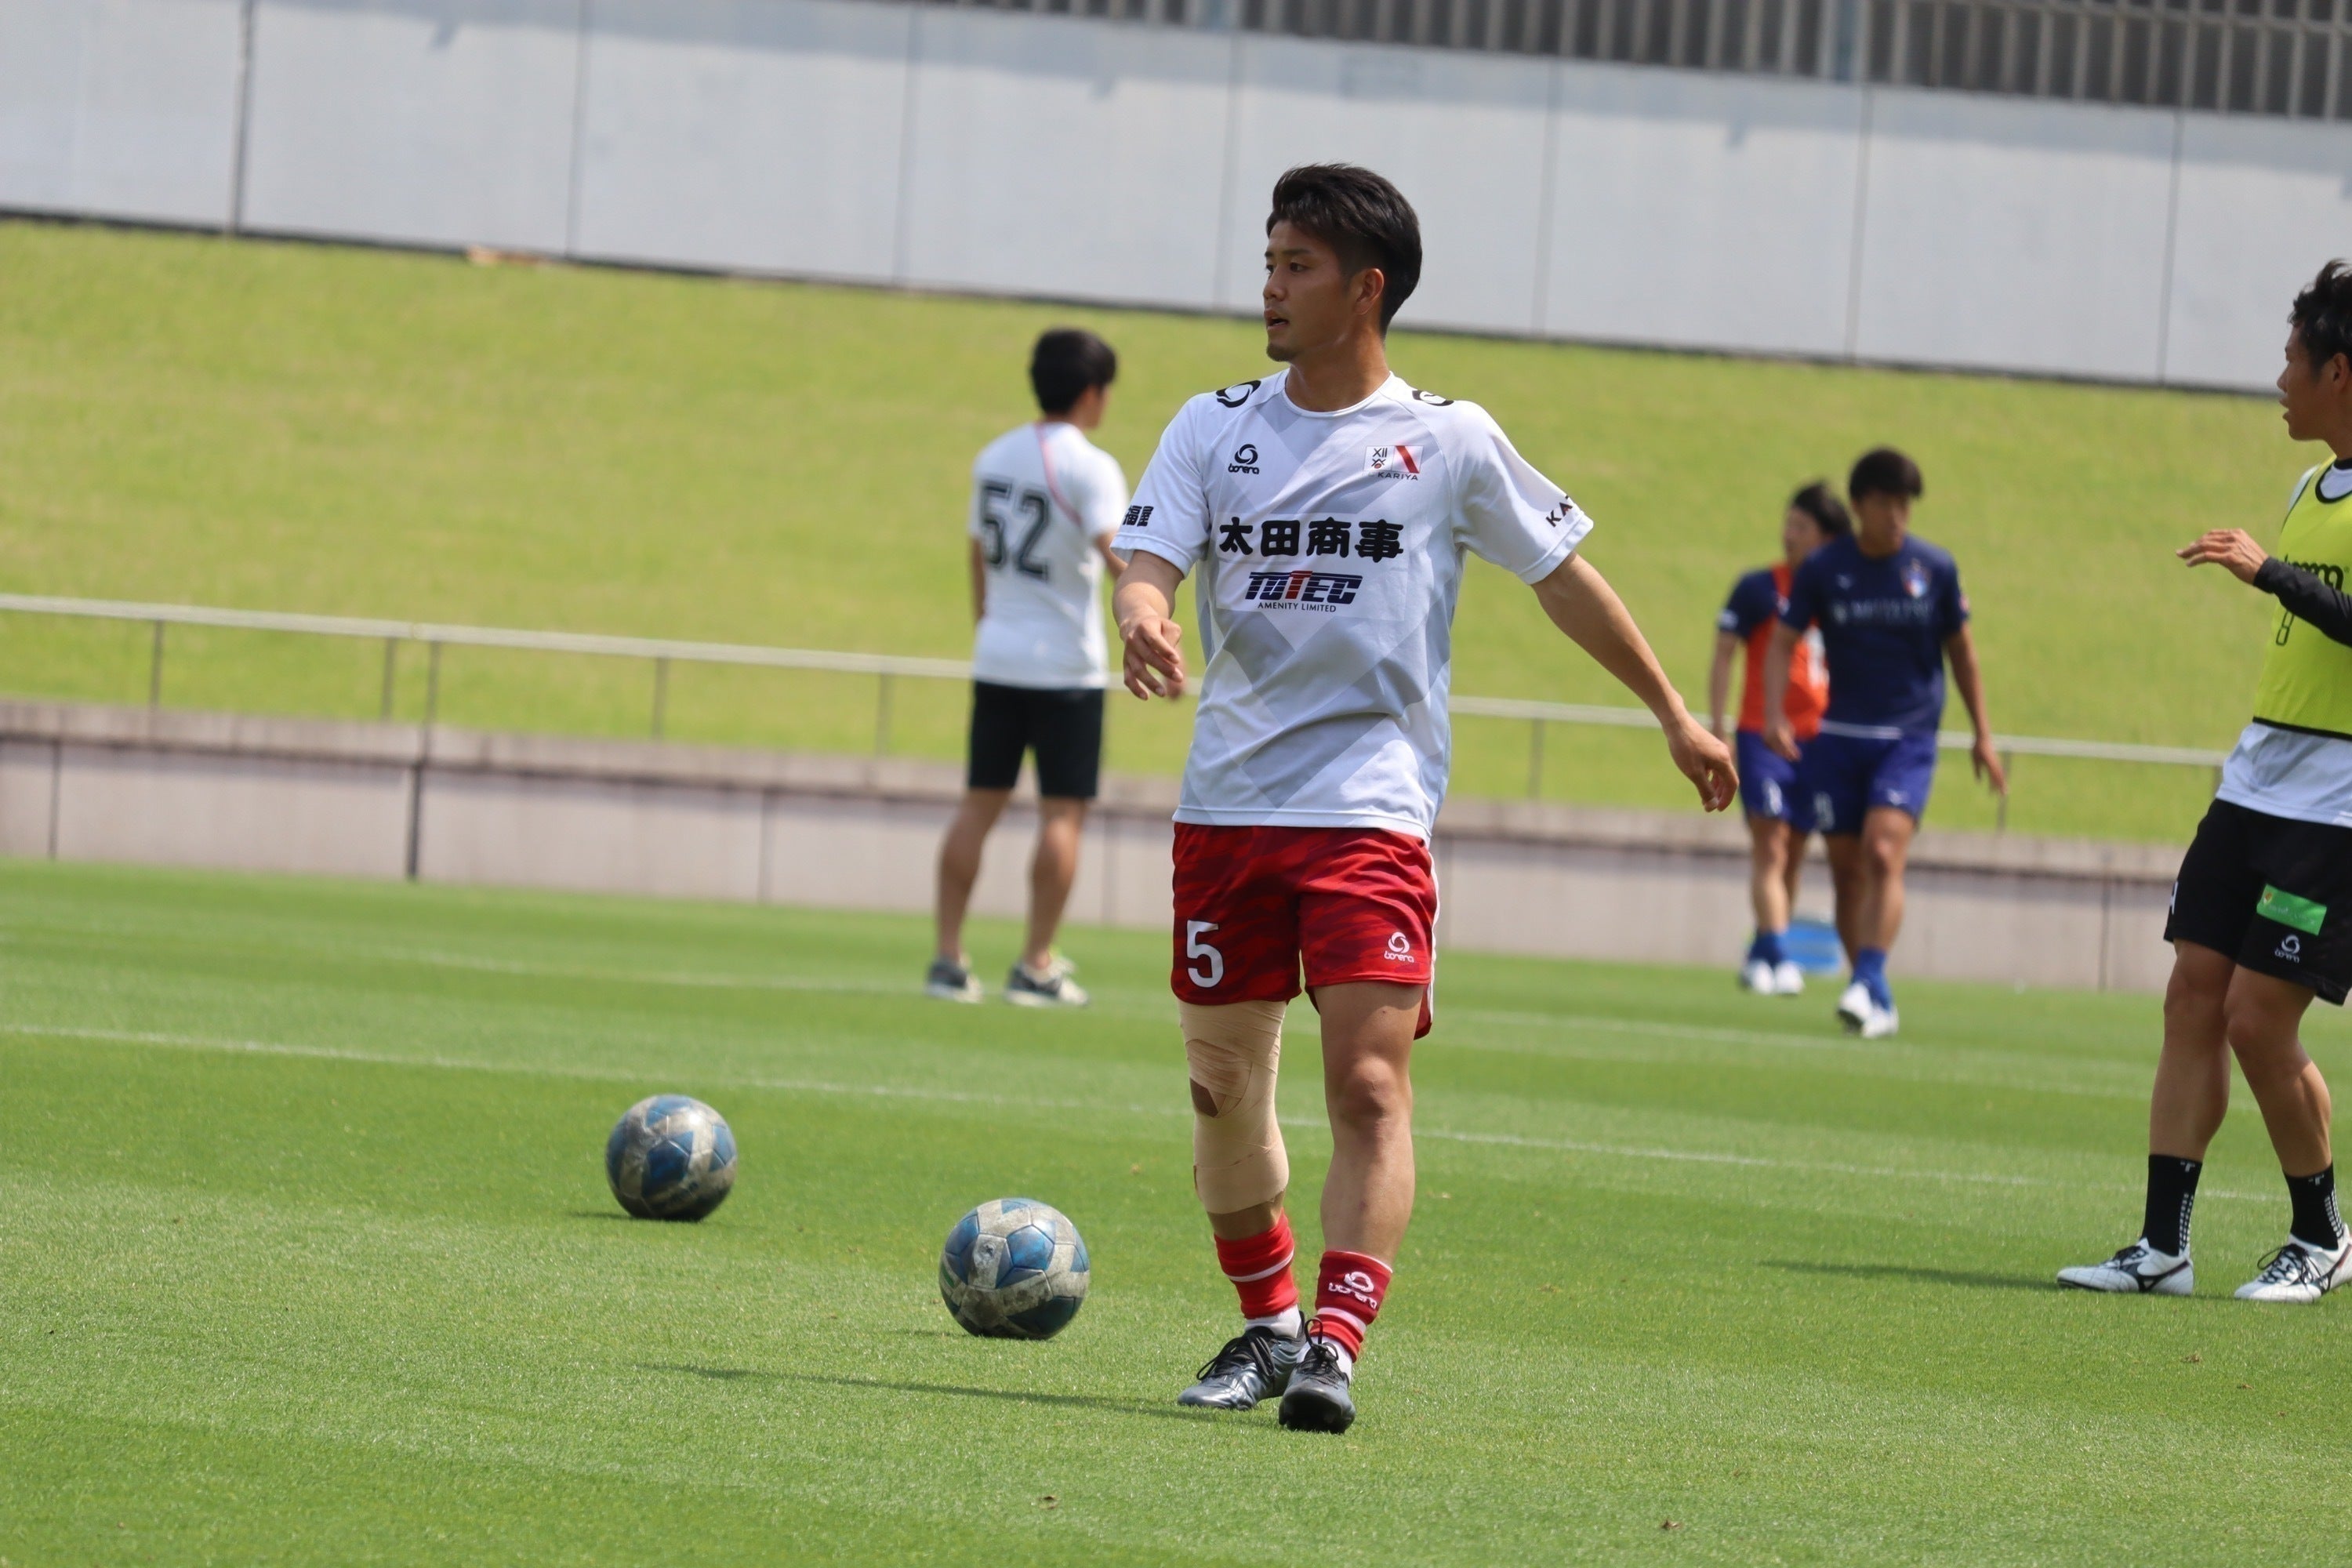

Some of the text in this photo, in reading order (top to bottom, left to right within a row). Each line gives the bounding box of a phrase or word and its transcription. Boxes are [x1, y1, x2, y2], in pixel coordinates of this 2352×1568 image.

[1377, 472, 1418, 481] KARIYA
[1545, 495, 1573, 528] KA
[982, 477, 1049, 583] 52
[1219, 516, 1404, 563] 太田商事
[1245, 570, 1363, 604] TOTEC
[1258, 601, 1337, 612] AMENITY LIMITED
[1187, 919, 1224, 988] 5
